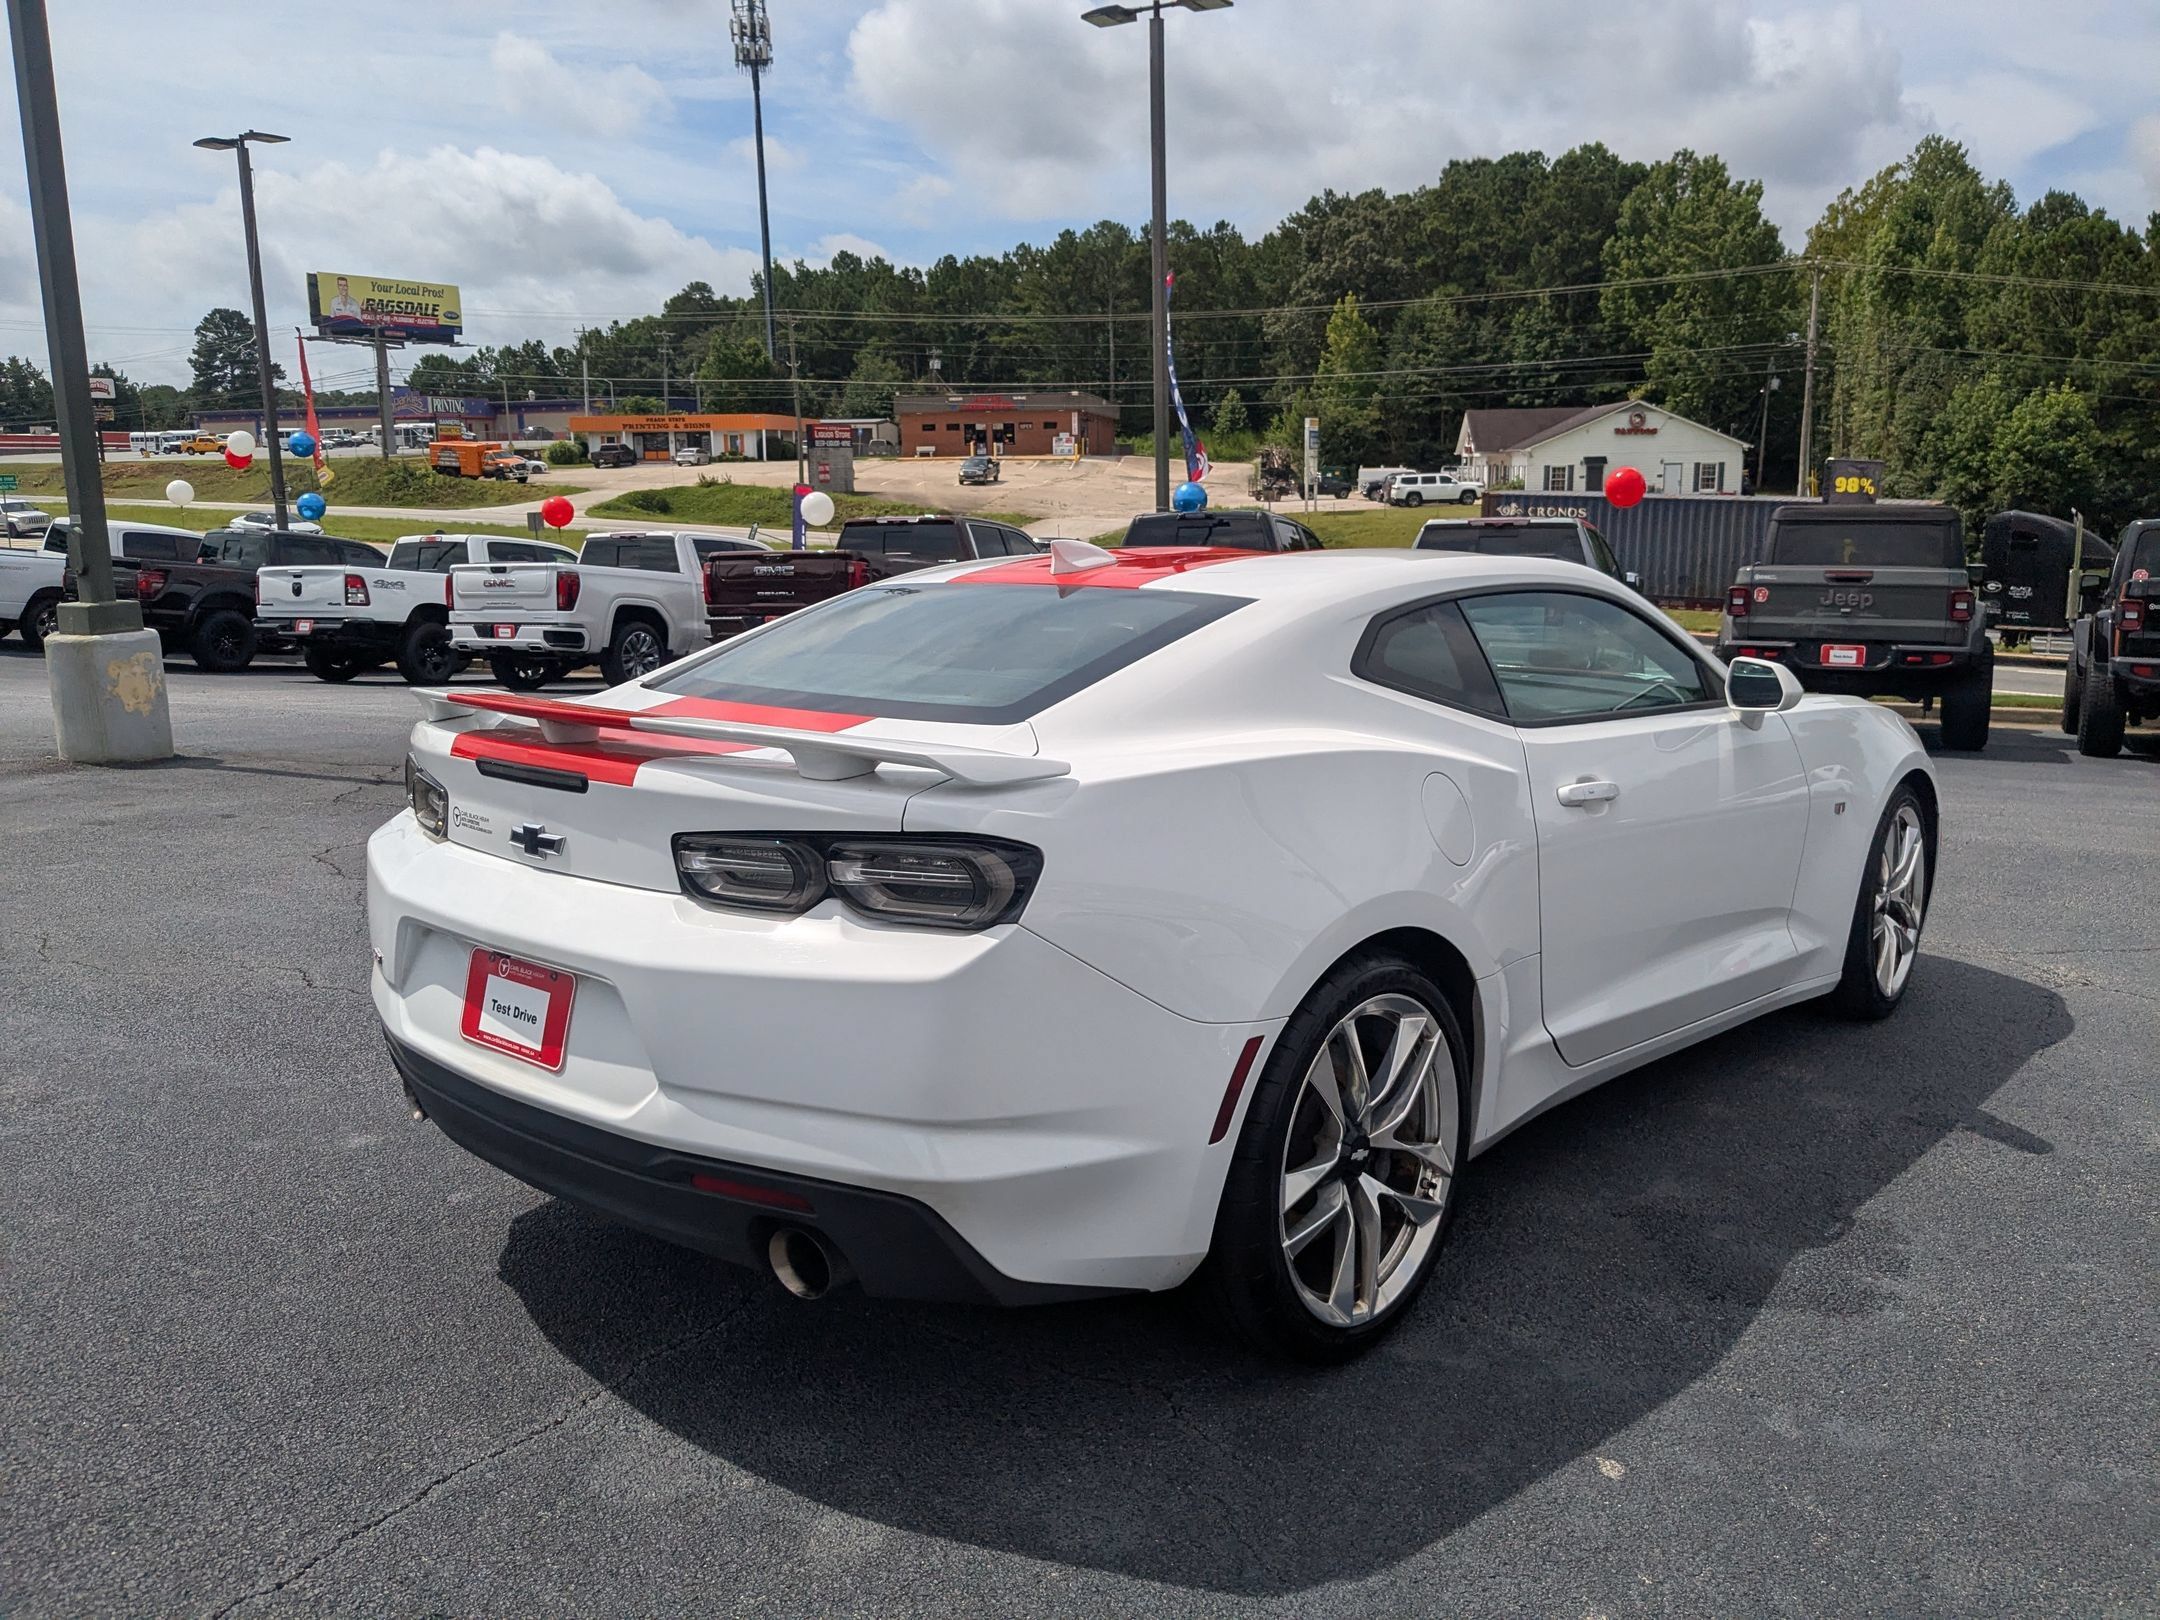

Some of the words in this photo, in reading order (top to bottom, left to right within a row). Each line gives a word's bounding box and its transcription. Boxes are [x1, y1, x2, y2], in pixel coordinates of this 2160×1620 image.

[371, 281, 394, 294] Your
[395, 283, 420, 296] Local
[422, 285, 444, 298] Pros!
[365, 298, 440, 317] RAGSDALE
[432, 398, 465, 413] PRINTING
[814, 430, 834, 439] LIQUOR
[835, 430, 851, 439] STORE
[1834, 476, 1877, 495] 98%
[1527, 506, 1587, 518] CRONOS
[753, 565, 795, 576] GMC
[483, 579, 516, 588] GMC
[1820, 589, 1873, 608] Jeep
[520, 967, 533, 975] BLACK
[491, 998, 511, 1017] Test
[513, 1006, 538, 1025] Drive
